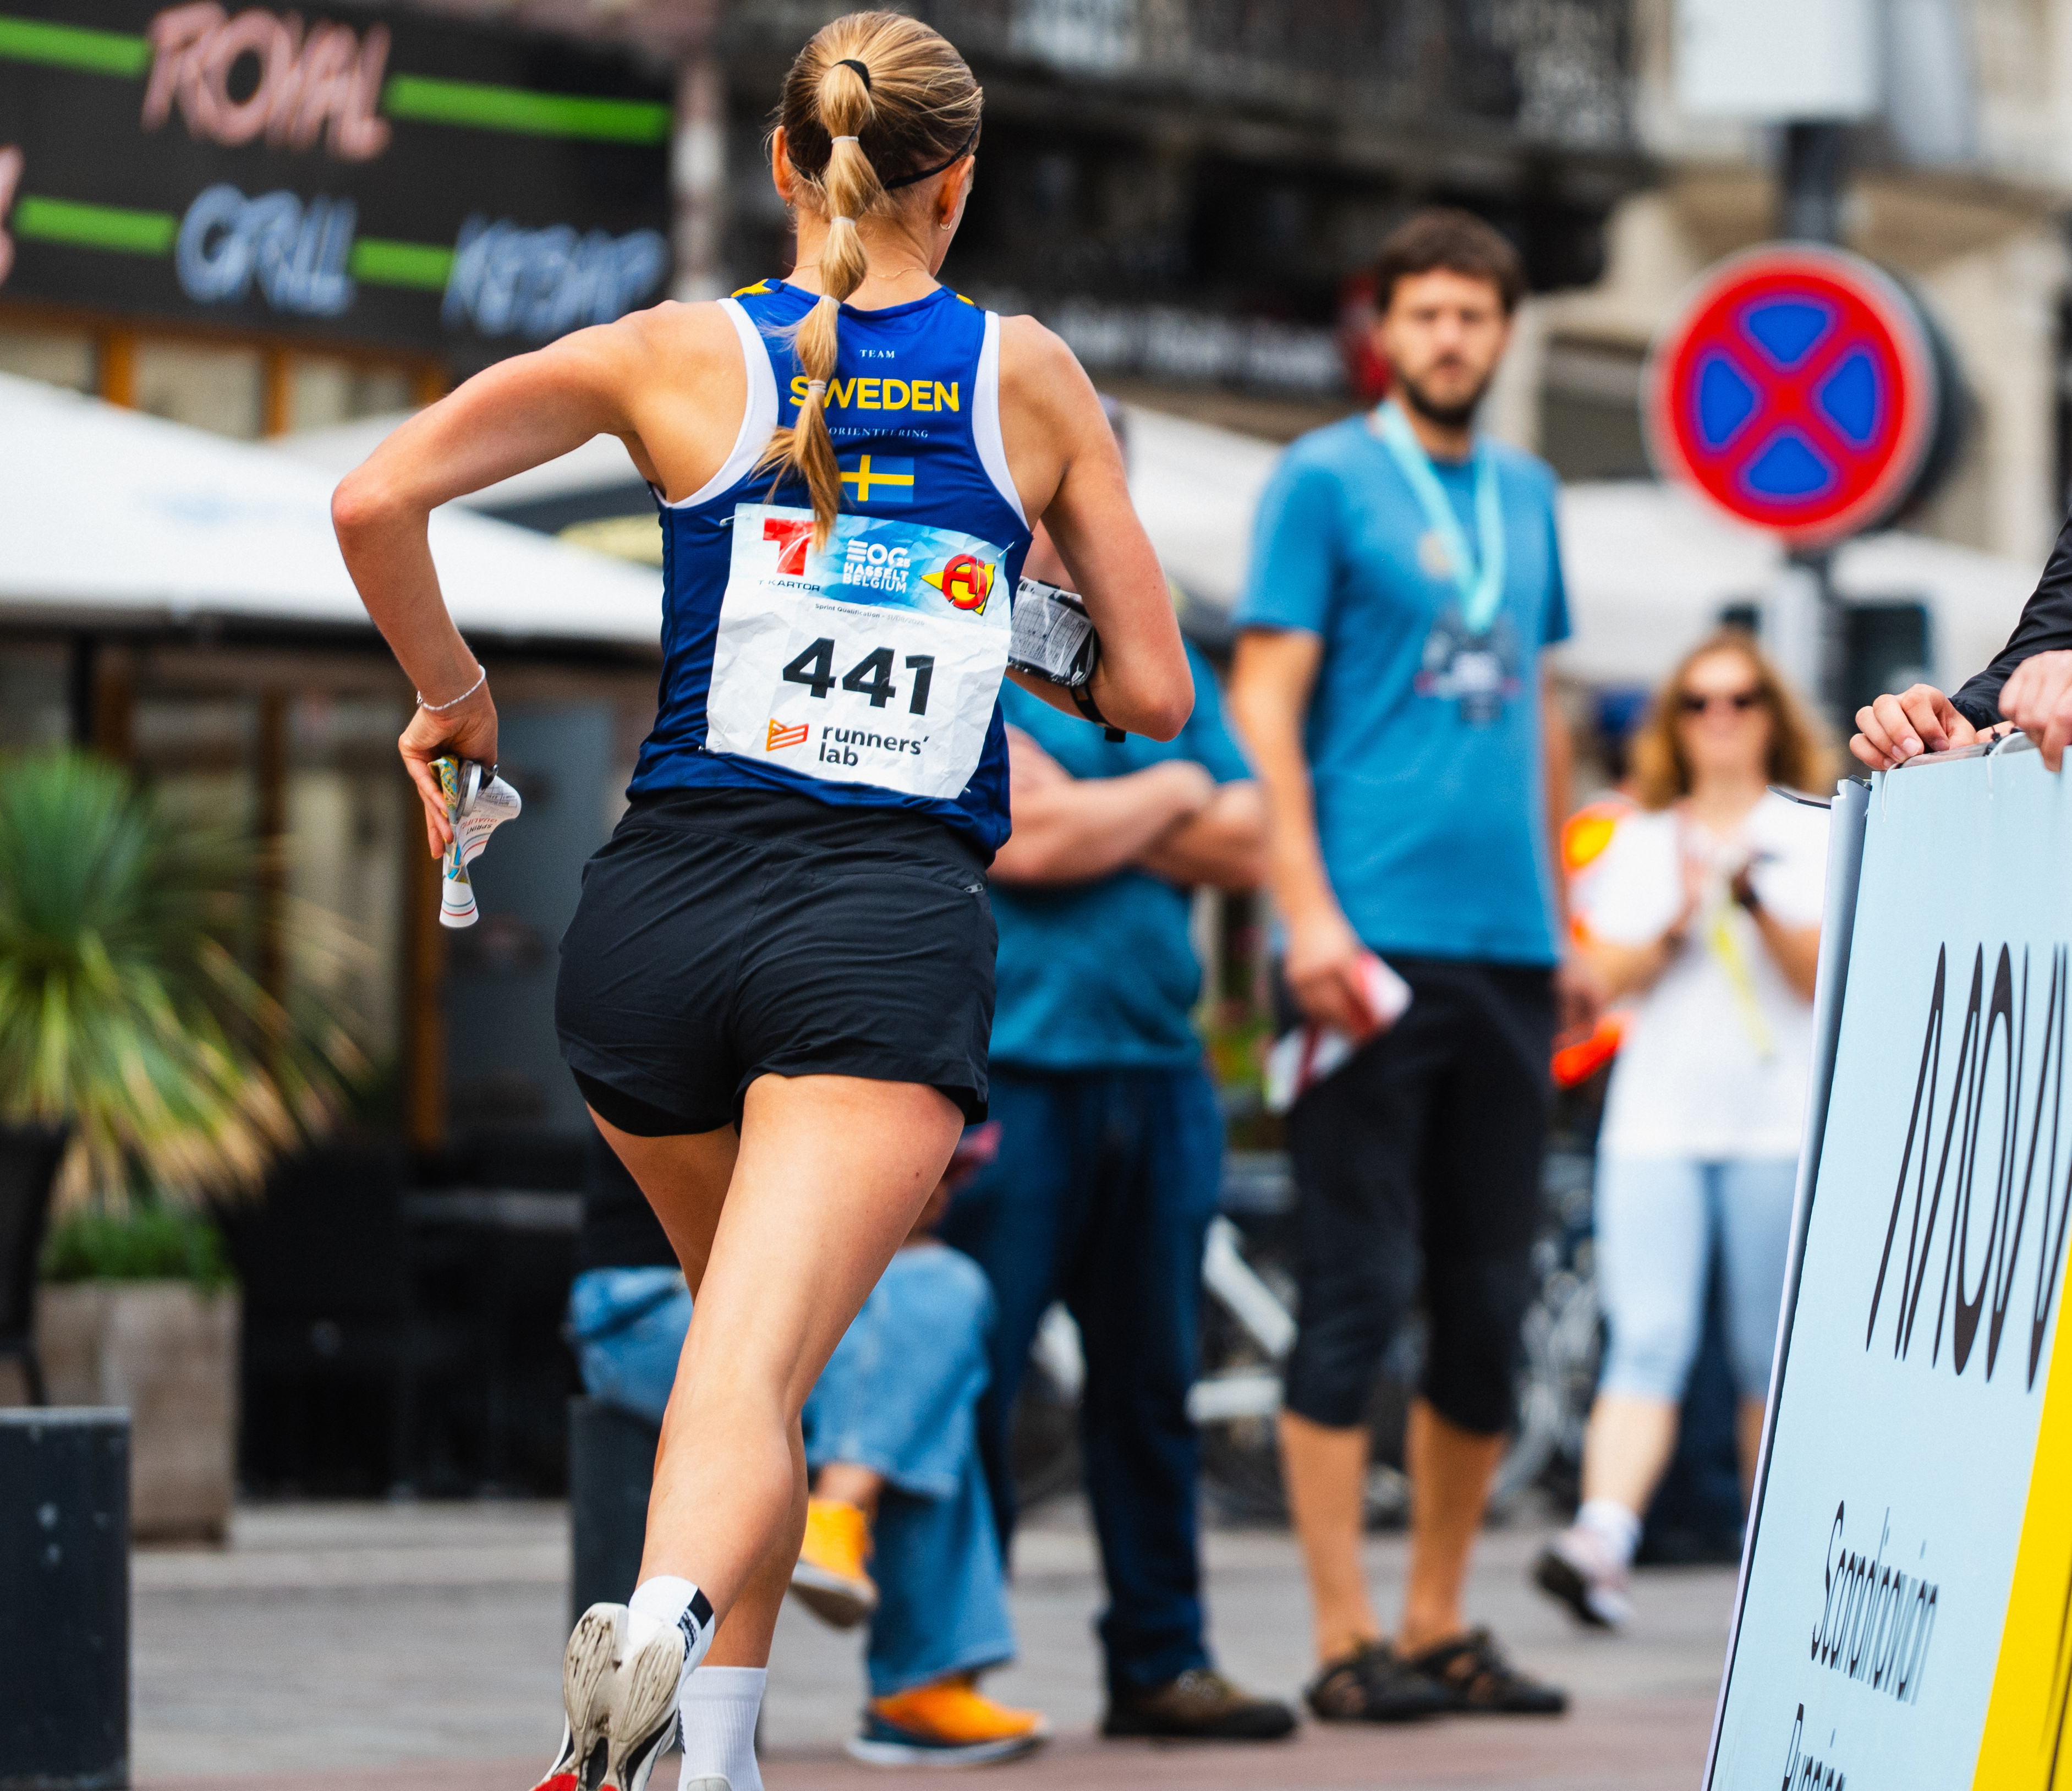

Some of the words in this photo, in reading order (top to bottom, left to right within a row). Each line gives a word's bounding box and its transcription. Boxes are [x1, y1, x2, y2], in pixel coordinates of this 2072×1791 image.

[860, 349, 895, 359] TEAM
[790, 376, 960, 412] SWEDEN
[829, 426, 929, 438] ORIENTEERING
[843, 562, 909, 582] HASSELT
[768, 579, 820, 591] KARTOR
[842, 573, 907, 594] BELGIUM
[837, 606, 880, 618] Qualification
[783, 637, 935, 715] 441
[819, 742, 858, 766] lab
[1811, 1500, 1939, 1706] Scandinavian
